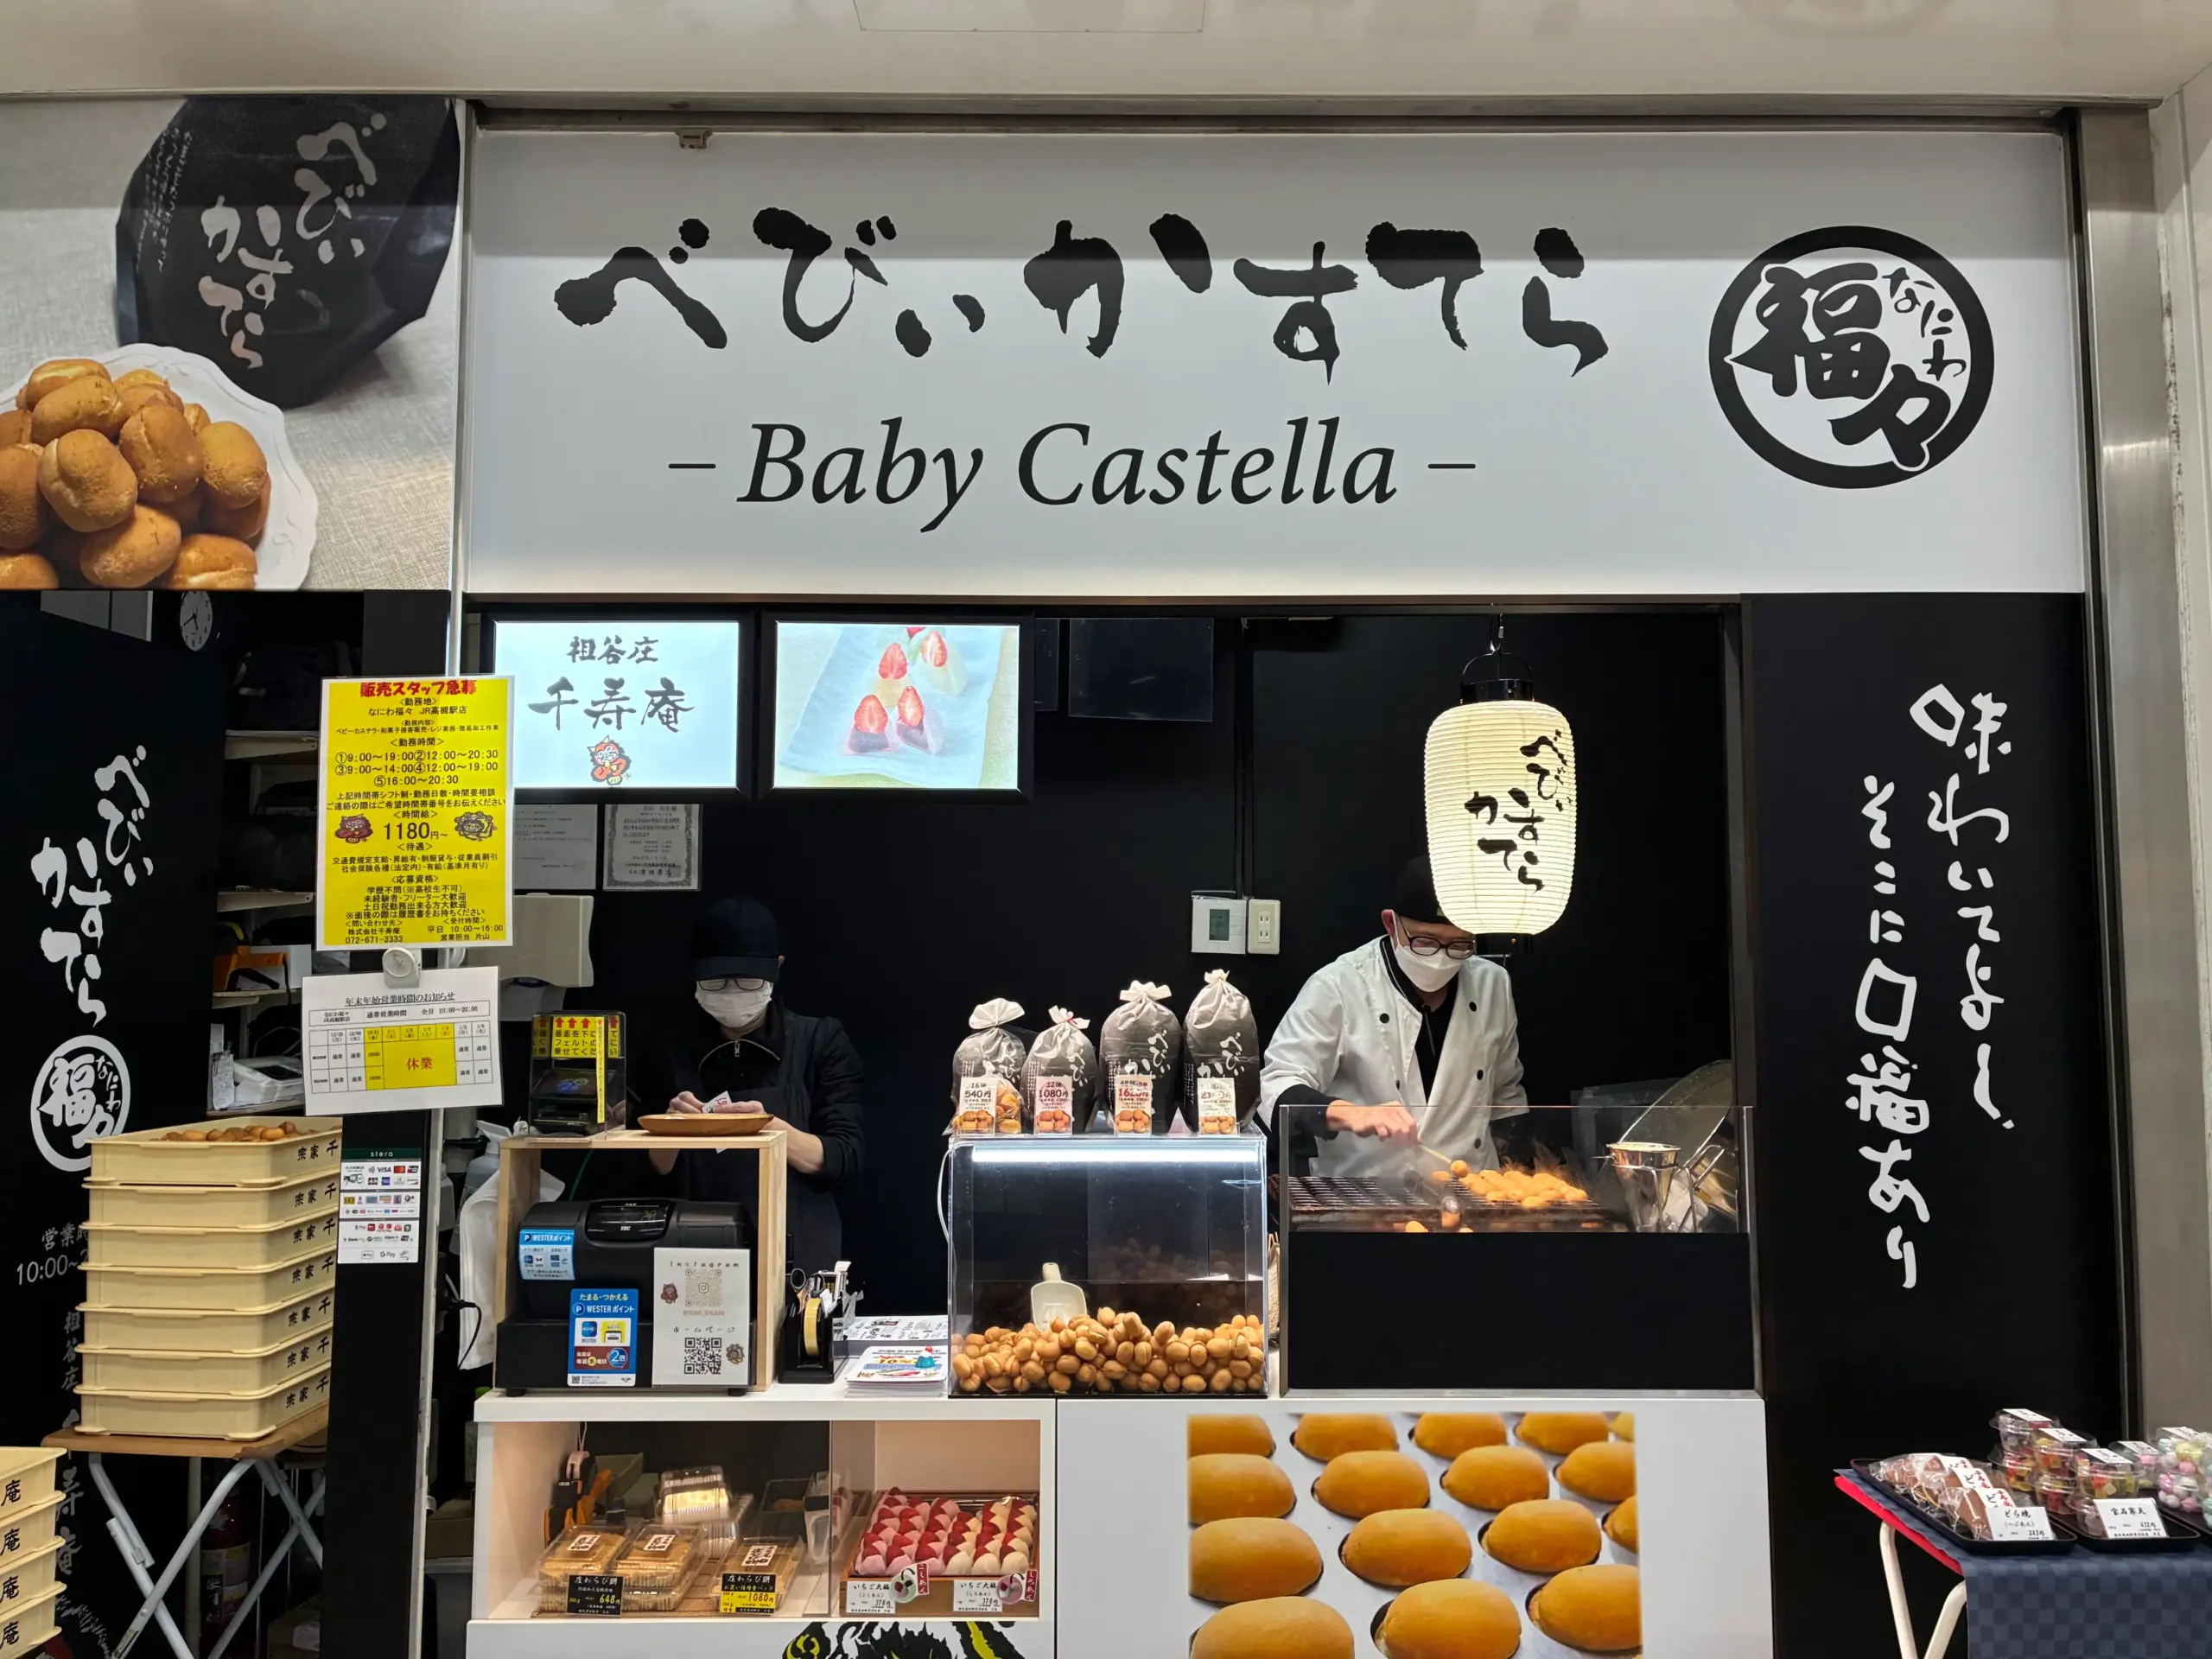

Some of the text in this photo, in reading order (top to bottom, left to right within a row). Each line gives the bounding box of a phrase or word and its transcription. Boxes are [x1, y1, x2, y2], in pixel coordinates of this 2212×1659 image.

[1882, 267, 1967, 381] なにわ
[736, 416, 1398, 532] Baby Castella
[565, 635, 659, 664] 祖谷庄
[360, 680, 477, 697] 販売スタッフ急募
[420, 706, 467, 715] JR高槻駅店
[528, 676, 695, 733] 千寿庵
[346, 935, 403, 944] 072-671-3333
[345, 993, 454, 1007] 年末年始営業時間のお知らせ
[366, 1009, 407, 1018] 通常営業時間
[406, 1057, 433, 1070] 休業
[96, 1055, 121, 1111] なにわ
[965, 1090, 991, 1098] 540円
[1039, 1089, 1068, 1097] 1080円
[612, 1351, 626, 1362] 2倍
[1, 1480, 21, 1506] 庵
[0, 1529, 20, 1556] 庵
[575, 1576, 617, 1586] 庄わらび餅
[0, 1576, 19, 1603] 庵
[600, 1594, 620, 1605] 648円
[749, 1592, 773, 1602] 1080円
[0, 1621, 19, 1649] 庵
